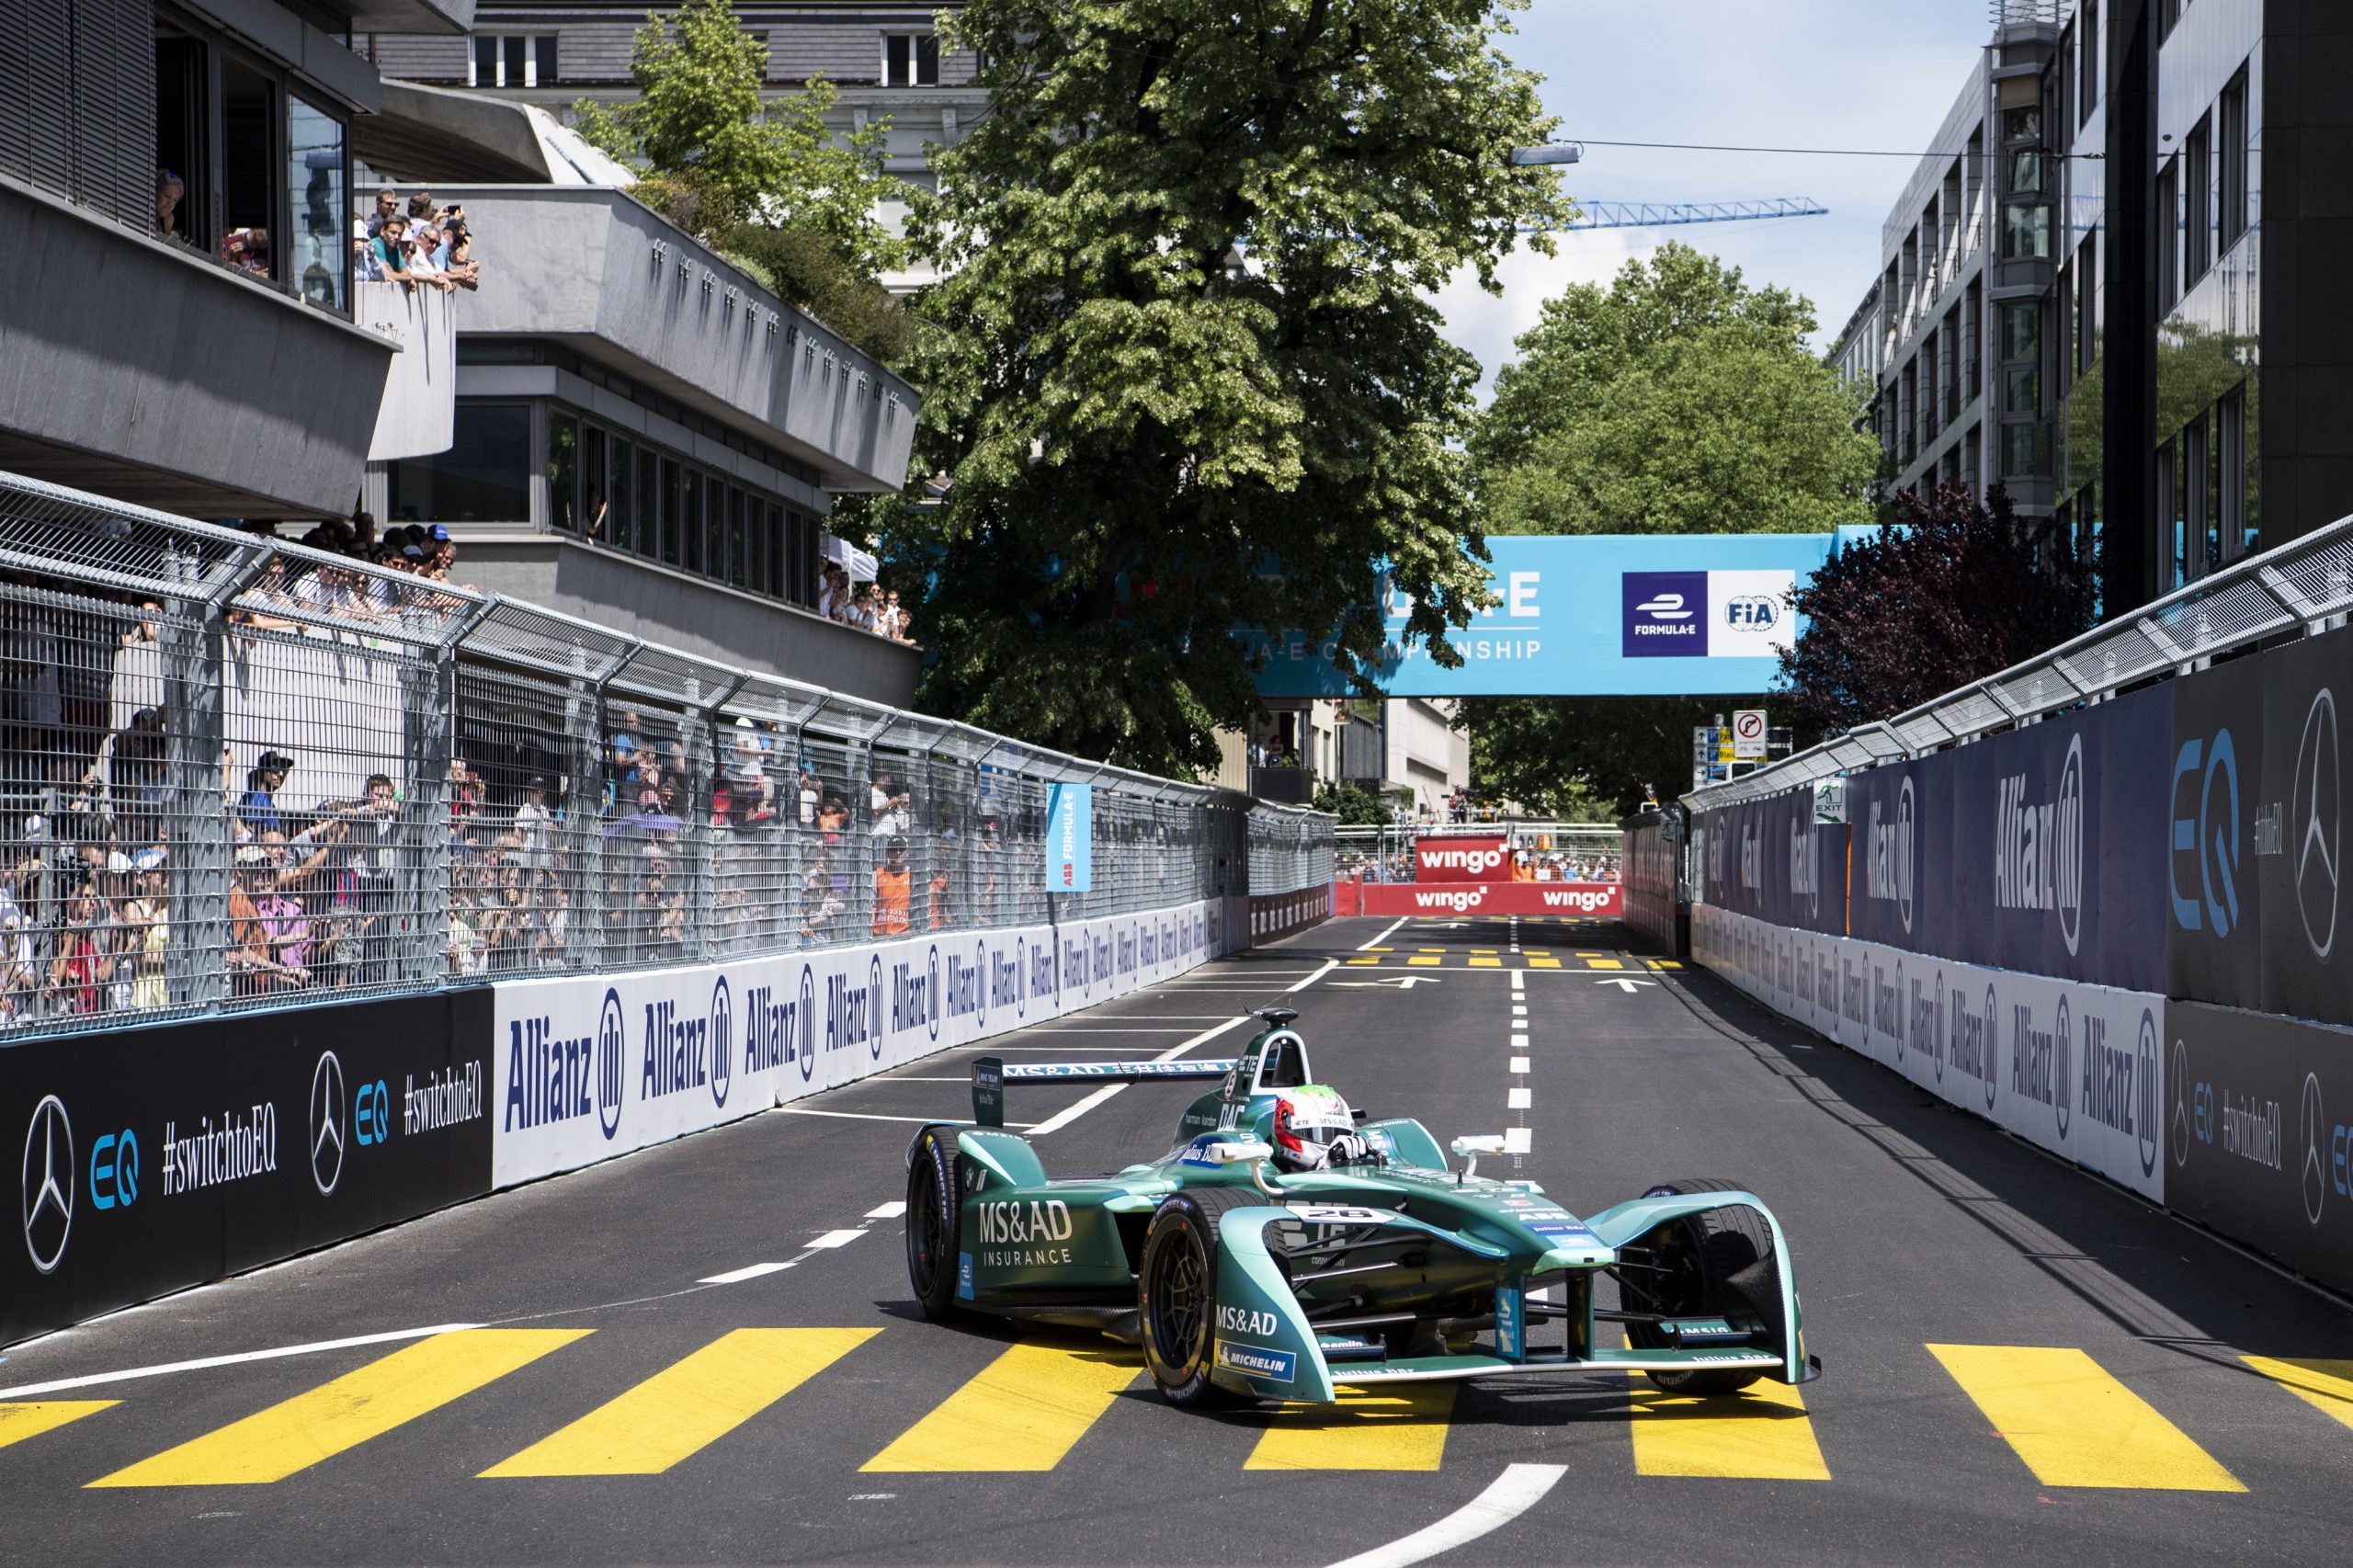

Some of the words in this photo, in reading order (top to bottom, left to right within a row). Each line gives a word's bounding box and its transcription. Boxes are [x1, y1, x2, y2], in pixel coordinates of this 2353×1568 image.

[1323, 640, 1540, 661] CMPINSHIP
[1421, 849, 1502, 874] wingo
[2170, 727, 2239, 938] EQ
[1063, 862, 1074, 887] ABB
[1415, 892, 1482, 912] wingo
[1543, 891, 1609, 912] wingo
[892, 962, 926, 1034] Allianz
[947, 954, 975, 1017] Allianz
[992, 949, 1016, 1009] Allianz
[1031, 944, 1051, 998] Allianz
[745, 985, 796, 1074] Allianz
[826, 972, 867, 1052] Allianz
[1910, 977, 1933, 1057] Allianz
[1950, 988, 1982, 1080] Allianz
[506, 1016, 591, 1132] Allianz
[642, 999, 706, 1101] Allianz
[1003, 1065, 1105, 1077] MS&AD
[2012, 1004, 2052, 1106] Allianz
[2082, 1015, 2132, 1136] Allianz
[356, 1079, 389, 1146] EQ
[404, 1060, 483, 1136] #switchtoEQ
[1201, 1115, 1217, 1127] kardon
[2194, 1081, 2214, 1145] EQ
[2222, 1088, 2282, 1172] #switchtoEQ
[90, 1128, 138, 1210] EQ
[163, 1101, 277, 1196] #switchtoEQ
[979, 1199, 1073, 1244] MS&AD
[983, 1248, 1073, 1267] INSURANCE
[1216, 1304, 1278, 1336] MS&AD
[1230, 1352, 1286, 1372] MICHELIN
